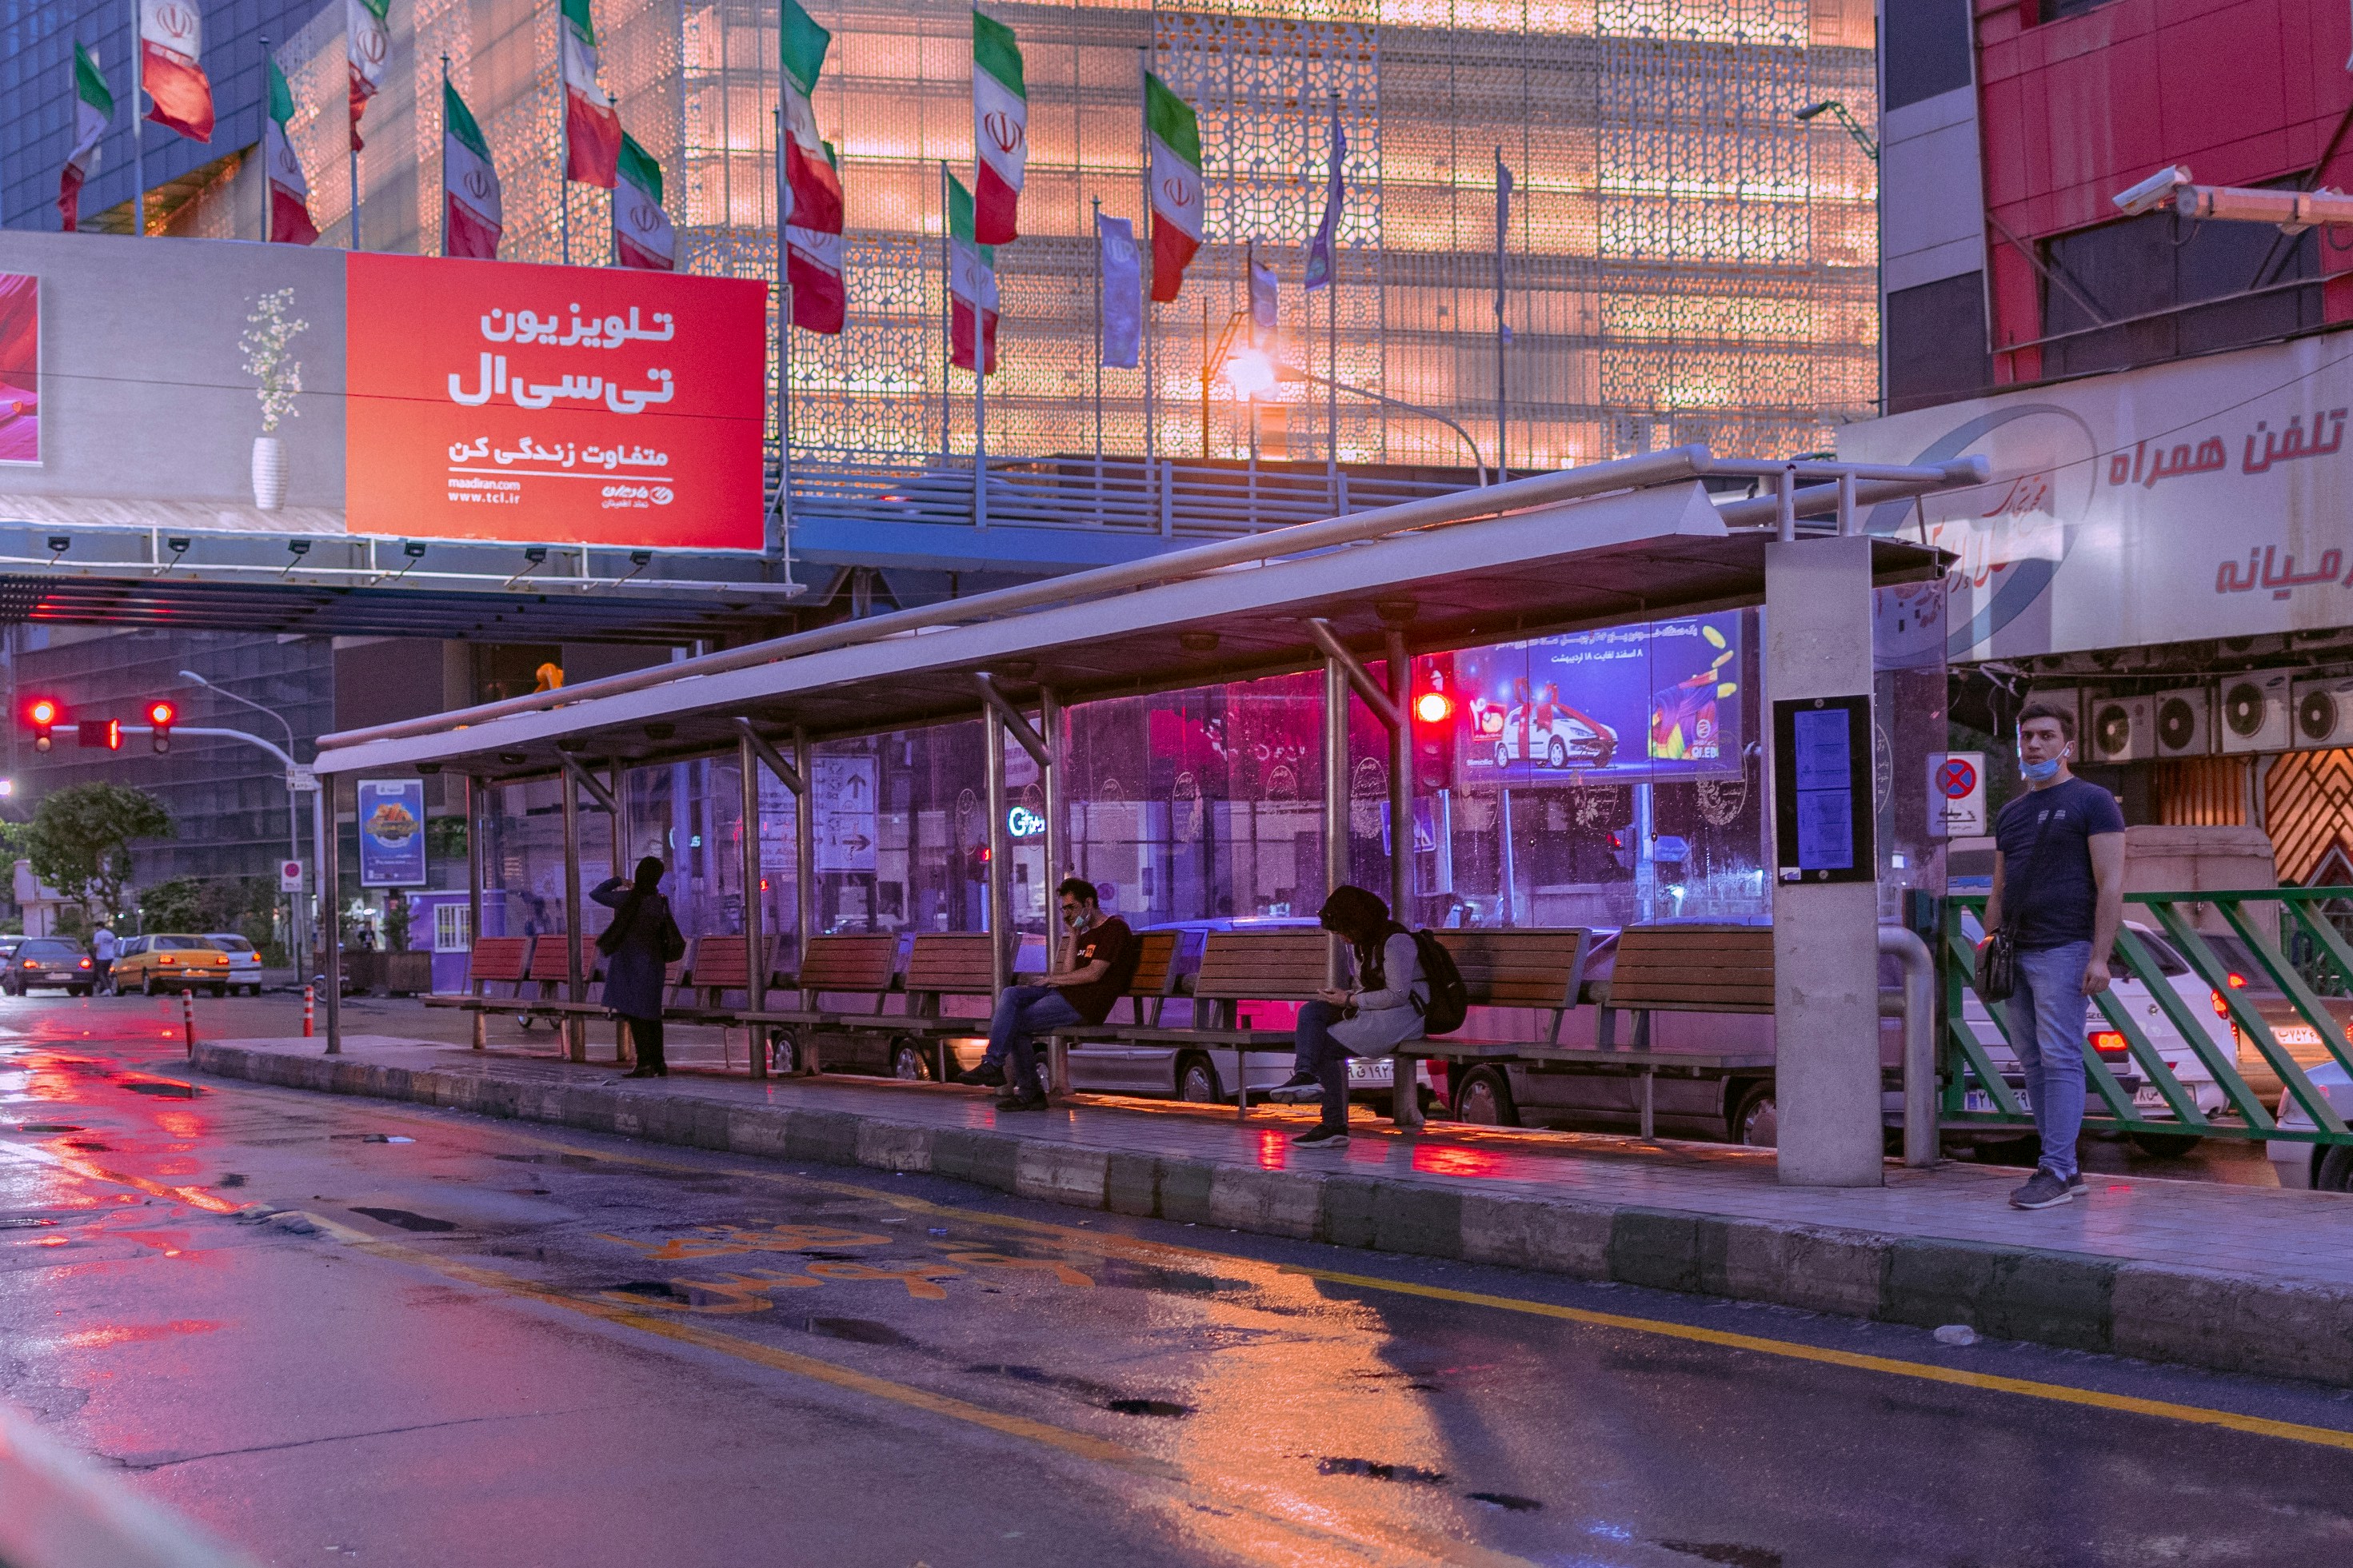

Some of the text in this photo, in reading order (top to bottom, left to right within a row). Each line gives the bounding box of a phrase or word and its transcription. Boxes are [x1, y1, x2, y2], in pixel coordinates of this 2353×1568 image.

[481, 303, 674, 349] تلویزیون
[448, 436, 669, 469] متفاوت زندگی کن
[2109, 408, 2347, 489] تلفن همراه
[448, 477, 521, 491] maadiran.com
[448, 492, 520, 504] www.tcl.ir
